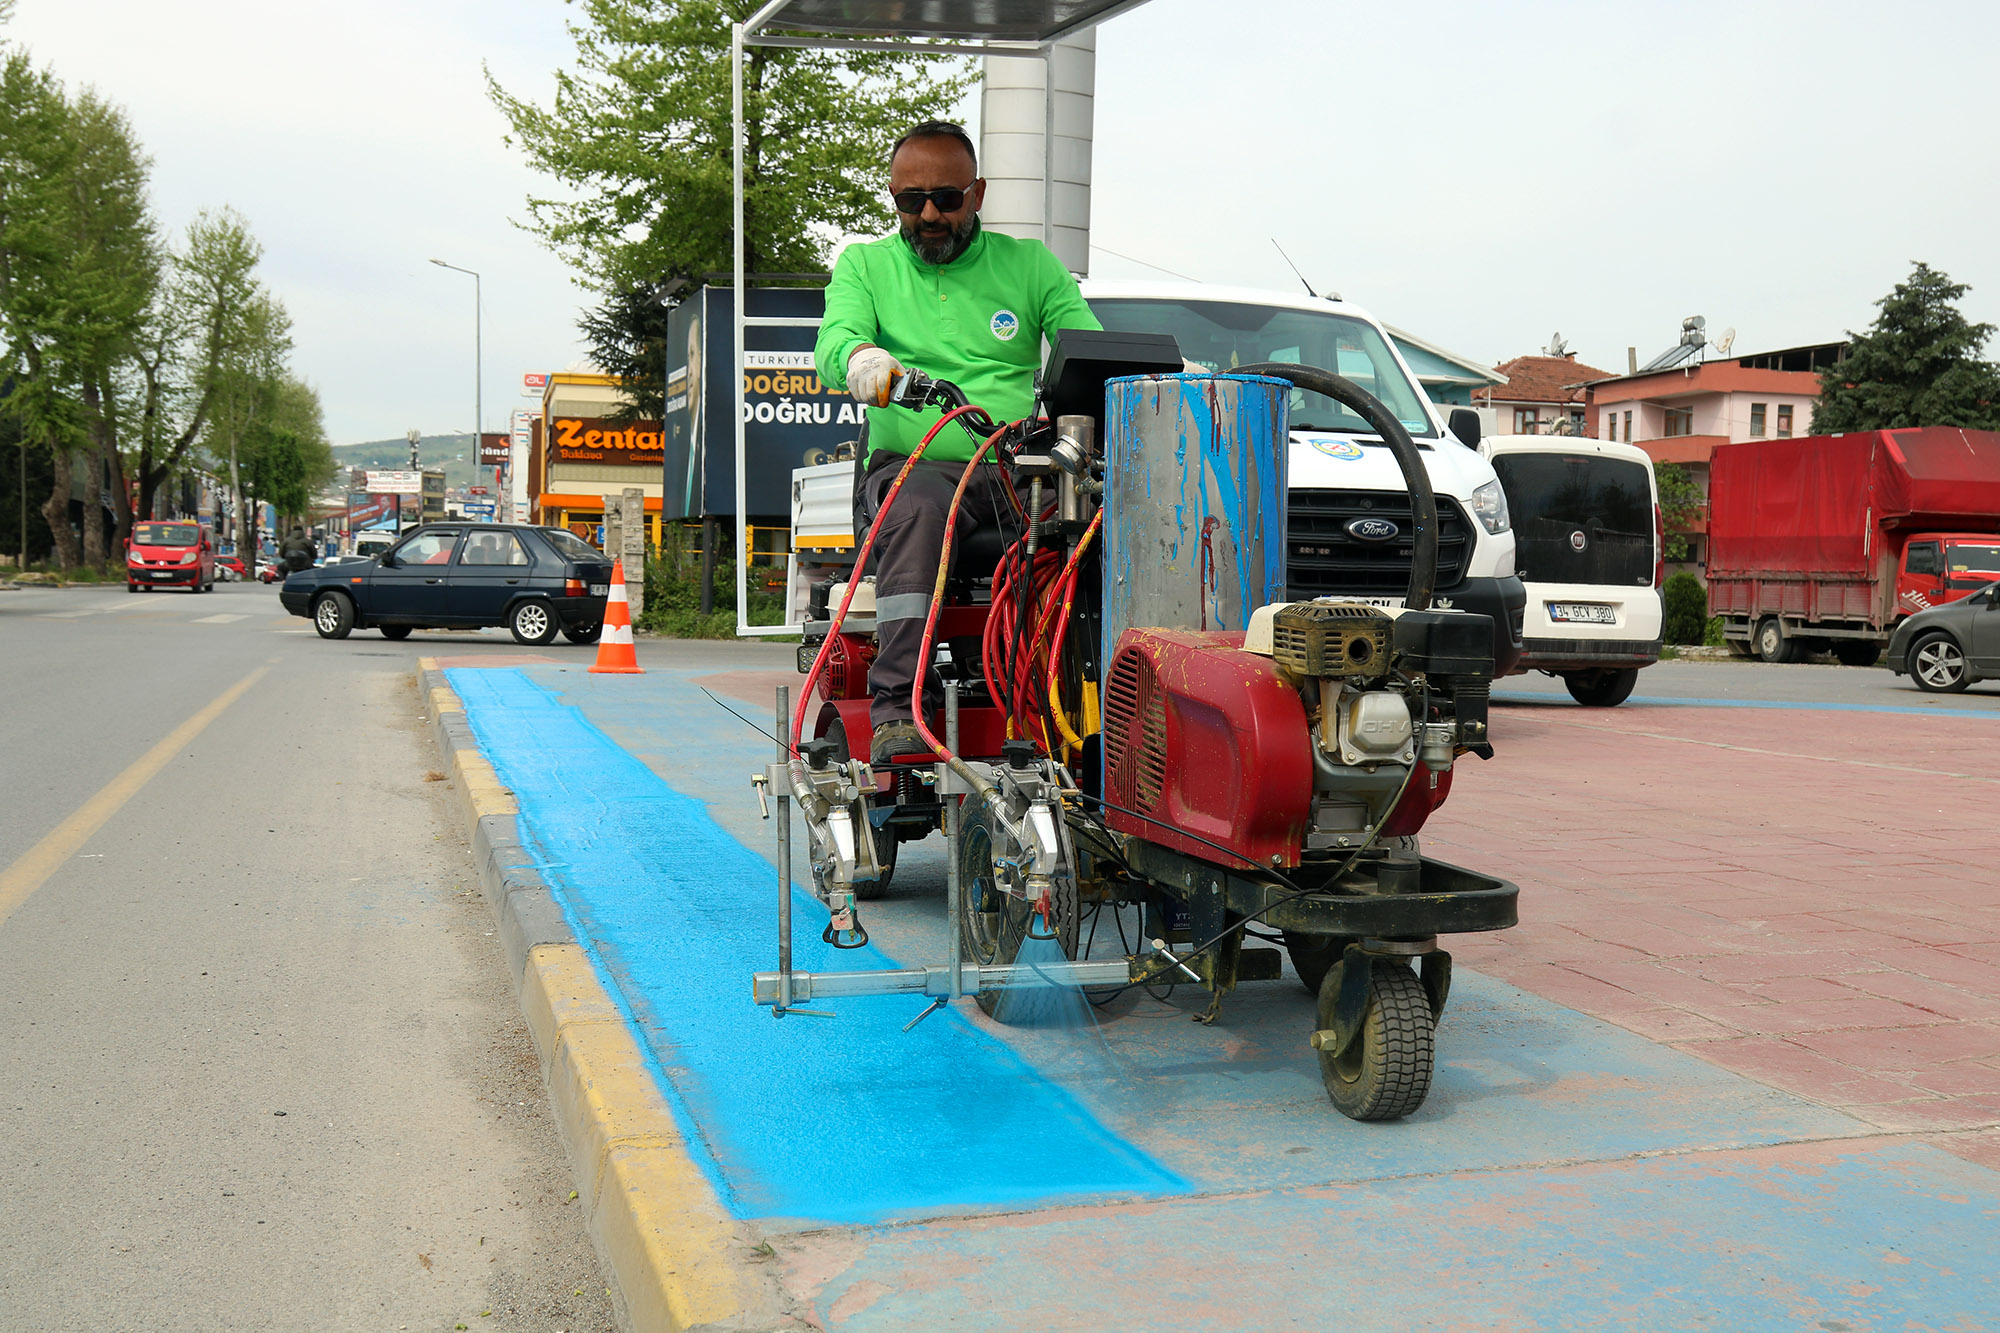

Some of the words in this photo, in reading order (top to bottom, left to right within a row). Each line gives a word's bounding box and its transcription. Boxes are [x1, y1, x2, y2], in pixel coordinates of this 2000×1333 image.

[1361, 521, 1390, 535] Ford
[1556, 605, 1569, 618] 34
[1572, 605, 1591, 618] GCV
[1594, 606, 1613, 619] 380
[1362, 720, 1410, 733] OHV
